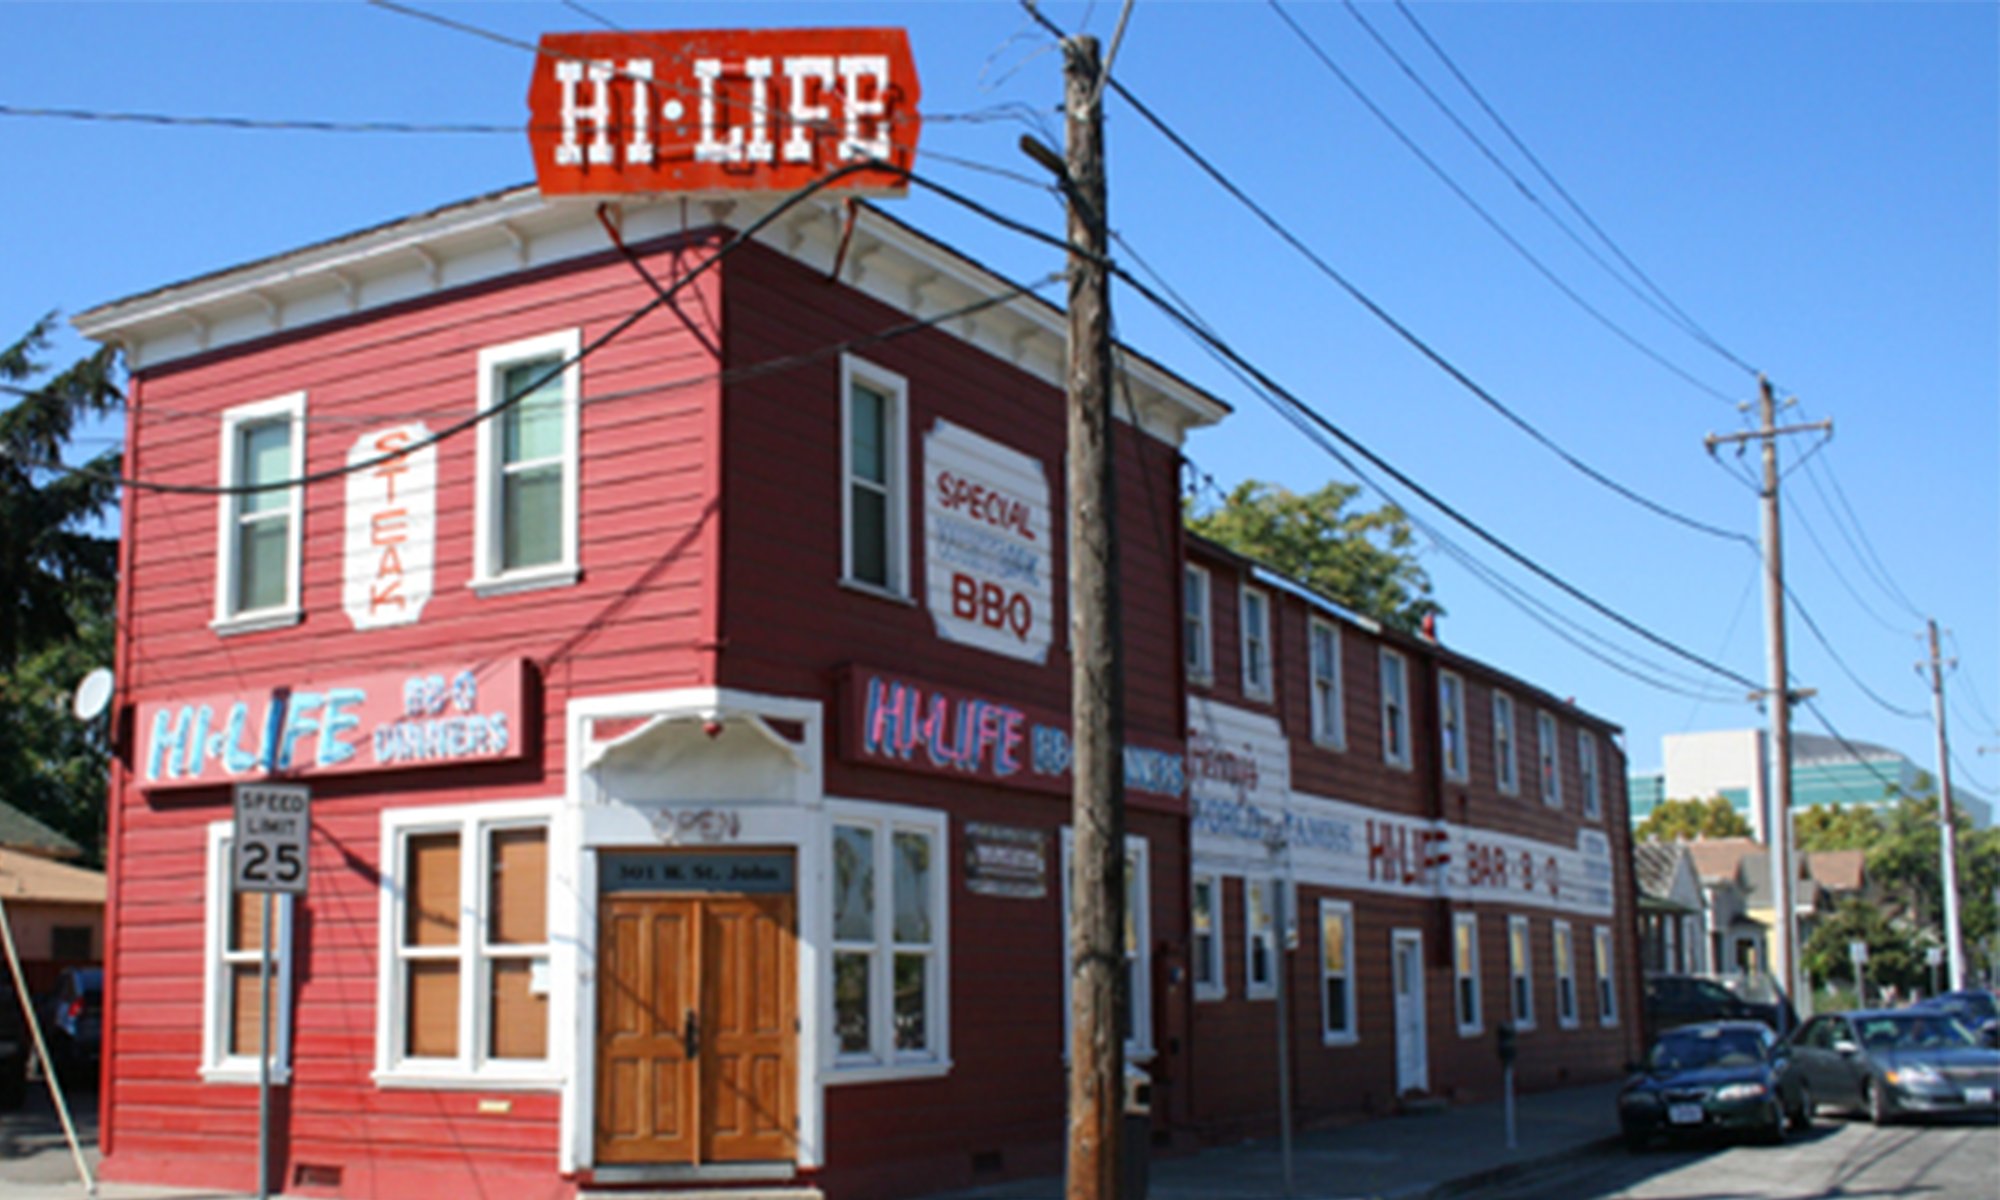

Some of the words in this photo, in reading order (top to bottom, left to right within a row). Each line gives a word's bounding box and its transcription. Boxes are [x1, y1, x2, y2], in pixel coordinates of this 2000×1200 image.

[370, 432, 409, 615] STEAK
[937, 470, 1036, 542] SPECIAL
[952, 571, 1032, 644] BBQ
[373, 711, 509, 764] DINNERS
[241, 790, 305, 812] SPEED
[247, 817, 297, 837] LIMIT
[241, 841, 302, 884] 25
